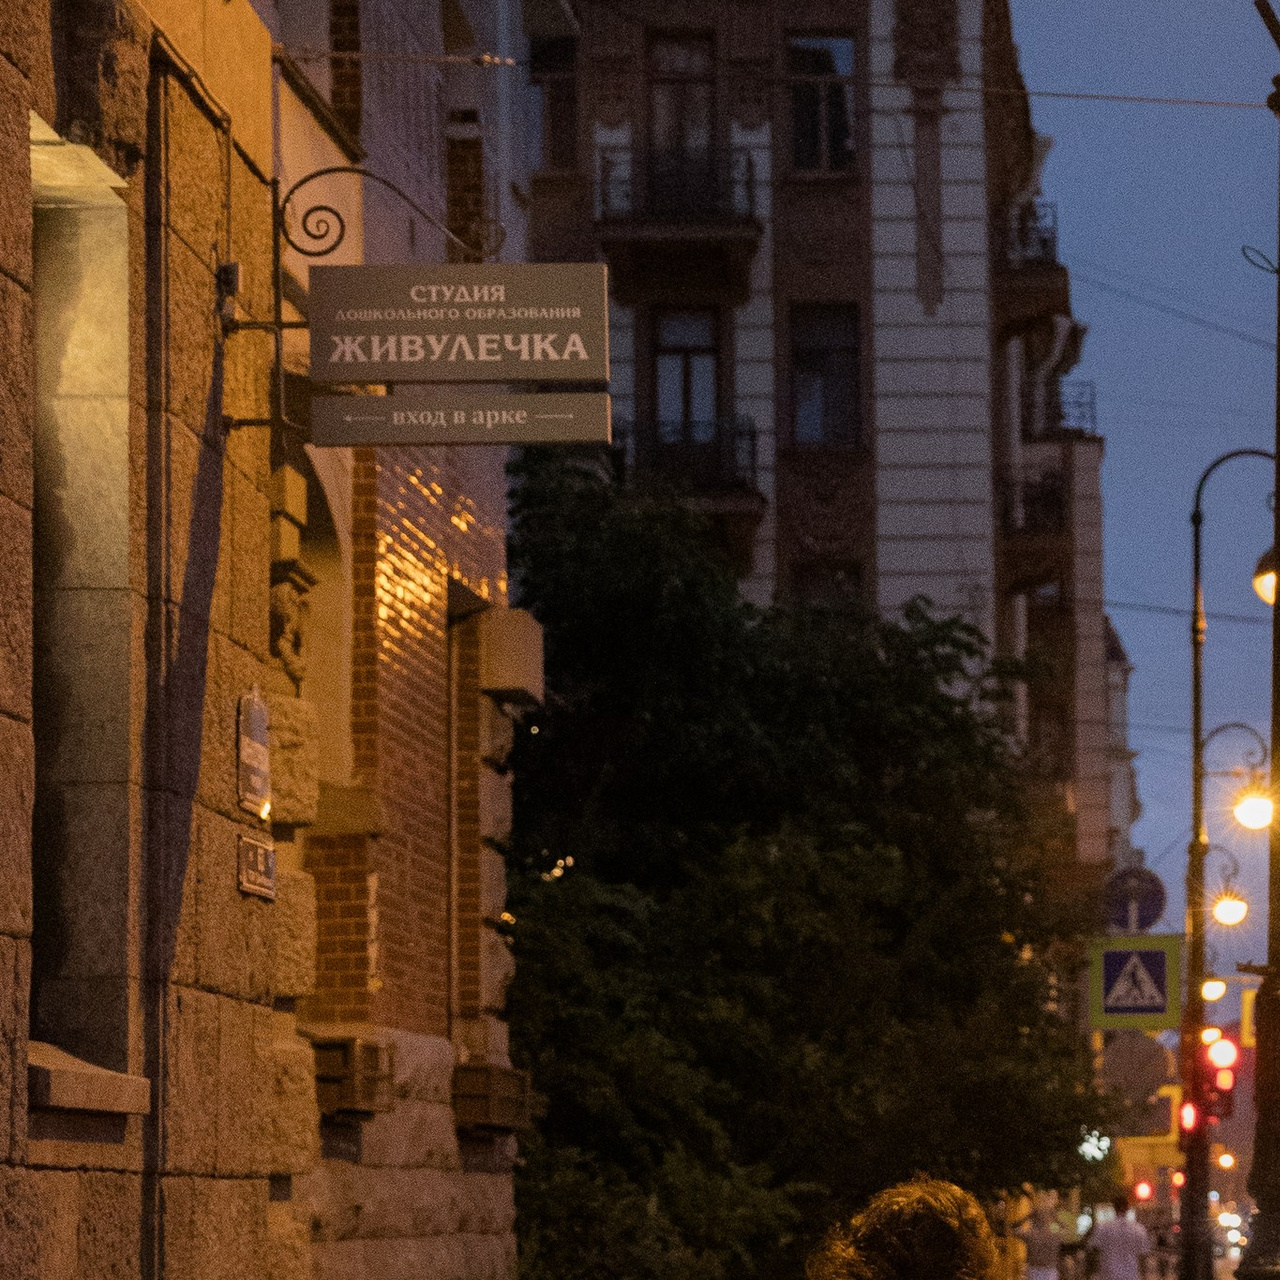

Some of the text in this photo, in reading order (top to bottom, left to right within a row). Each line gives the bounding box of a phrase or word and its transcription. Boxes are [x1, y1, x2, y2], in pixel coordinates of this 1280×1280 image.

[410, 285, 507, 303] СТУДИЯ
[335, 307, 582, 321] ДОШКОЛЬНОГО ОБРАЗОВАНИЯ
[329, 333, 590, 363] ЖИВУЛЕЧКА
[392, 408, 528, 429] вход в арке
